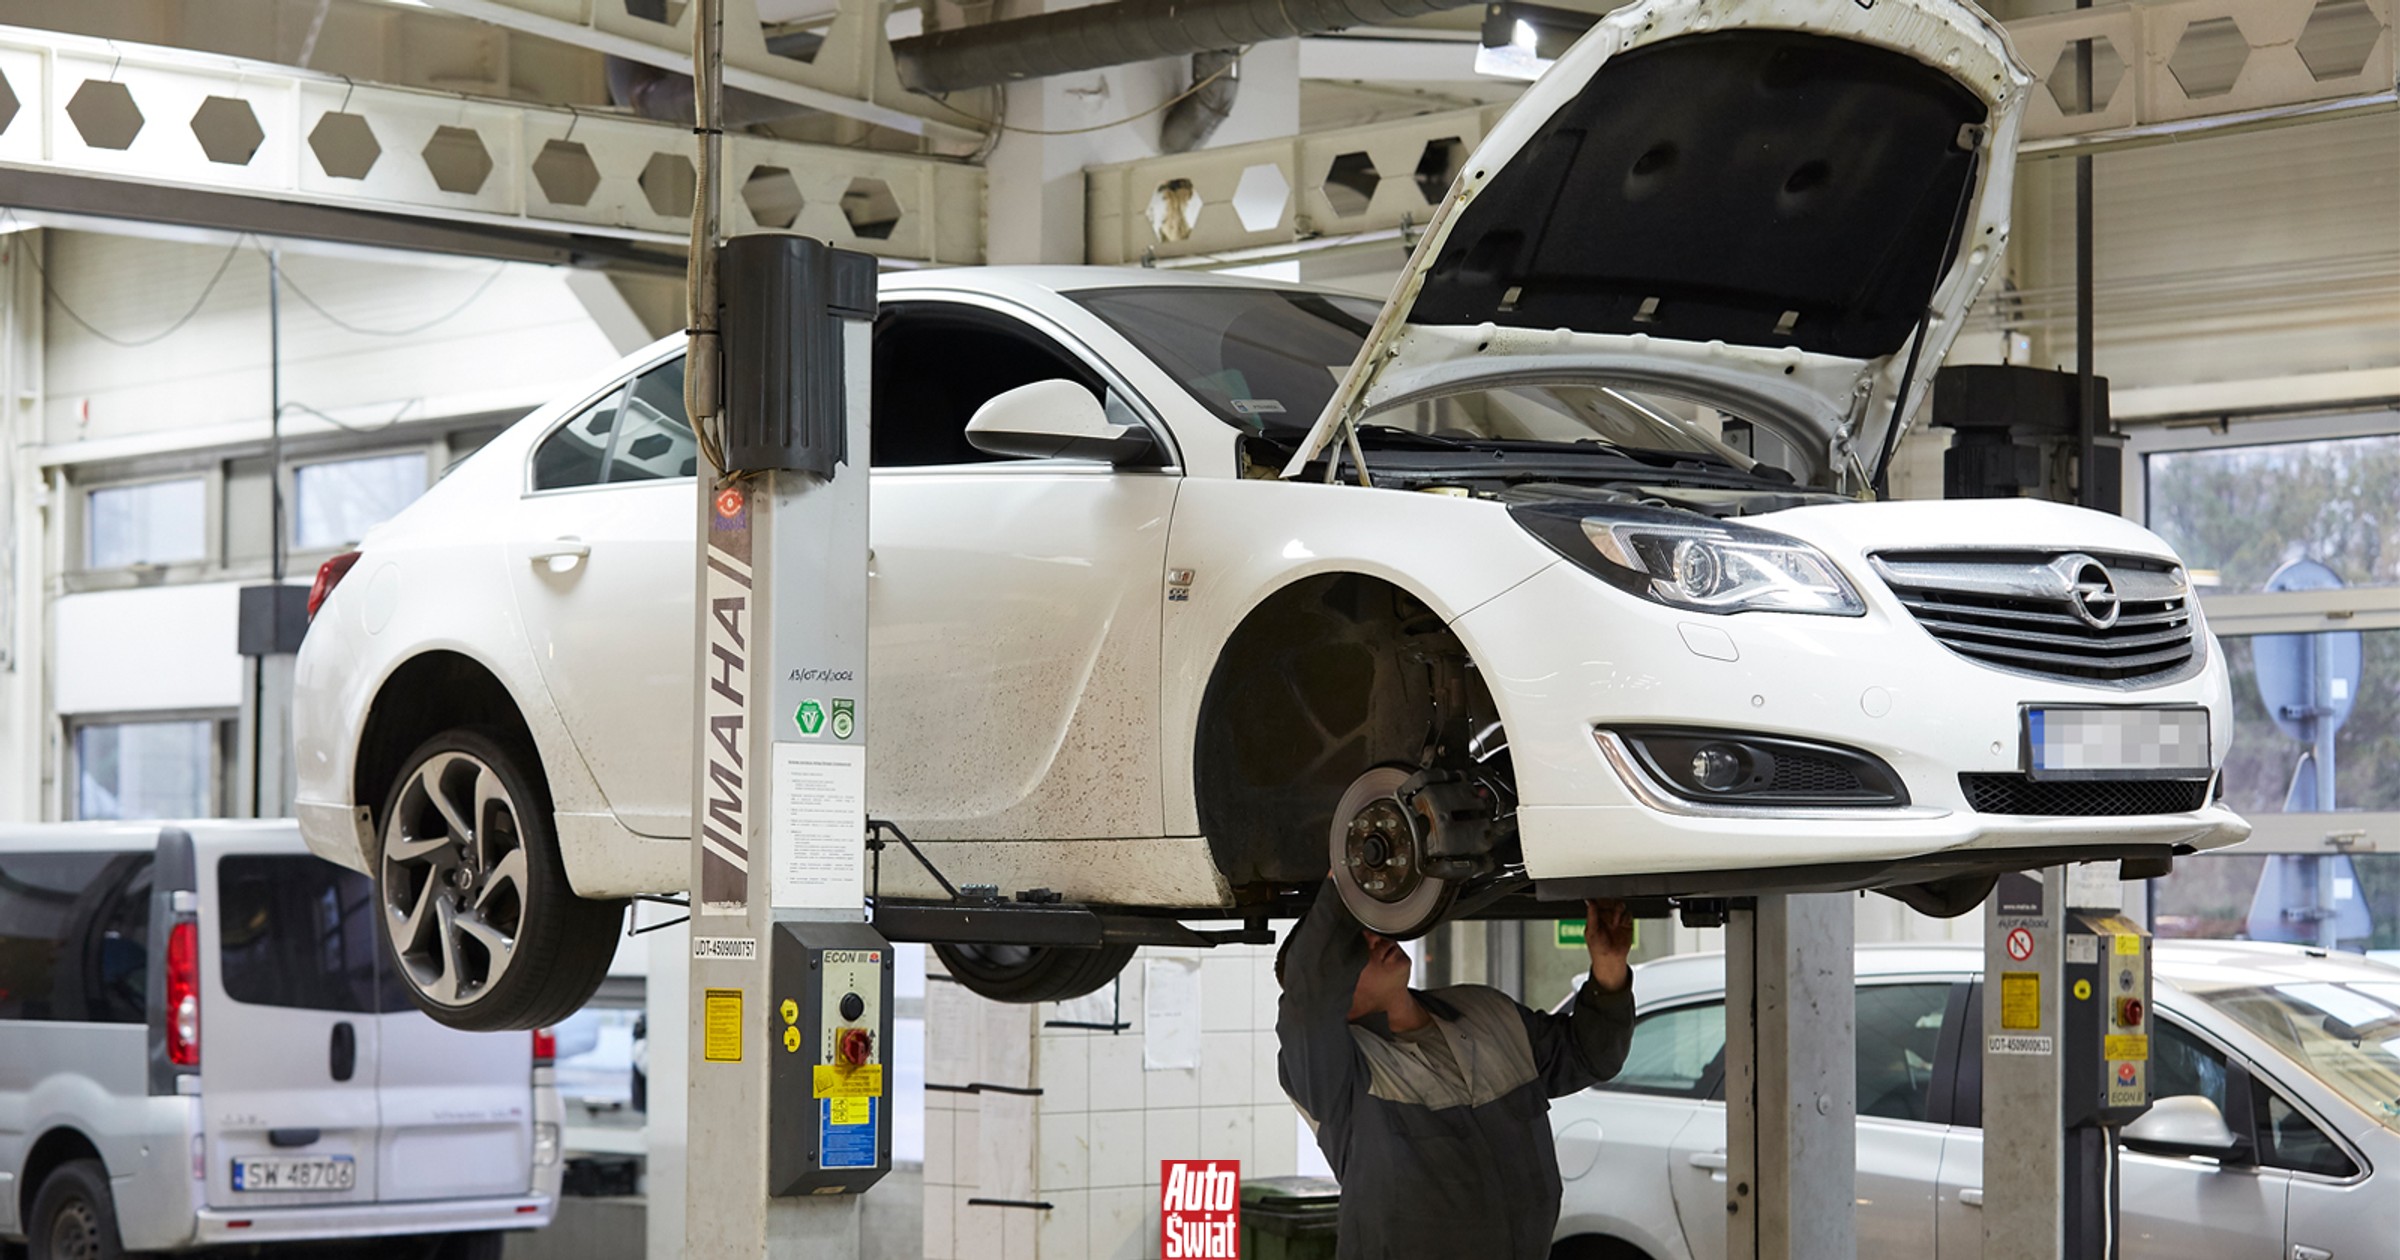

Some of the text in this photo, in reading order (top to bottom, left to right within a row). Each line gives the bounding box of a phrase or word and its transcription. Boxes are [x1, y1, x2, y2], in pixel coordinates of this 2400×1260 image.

[710, 597, 745, 836] MAHA
[824, 952, 856, 963] ECON
[2111, 1092, 2136, 1102] ECON
[248, 1162, 350, 1186] SW 48706
